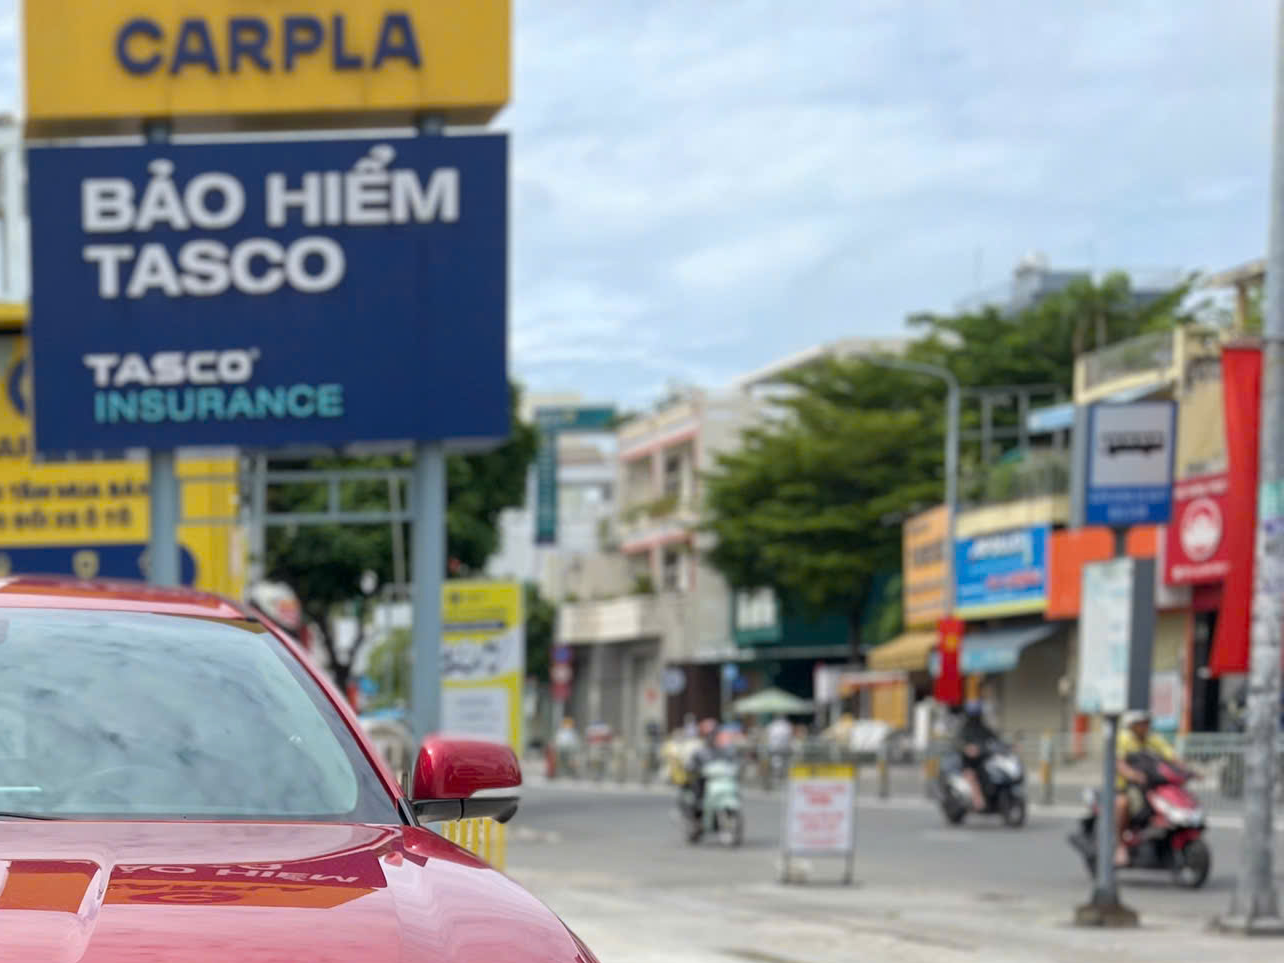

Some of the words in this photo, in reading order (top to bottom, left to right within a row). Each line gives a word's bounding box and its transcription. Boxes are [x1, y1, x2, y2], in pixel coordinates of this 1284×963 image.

[116, 12, 422, 76] CARPLA
[82, 158, 245, 232] BẢO
[265, 145, 459, 227] HIỂM
[82, 237, 345, 298] TASCO
[94, 383, 343, 423] INSURANCE
